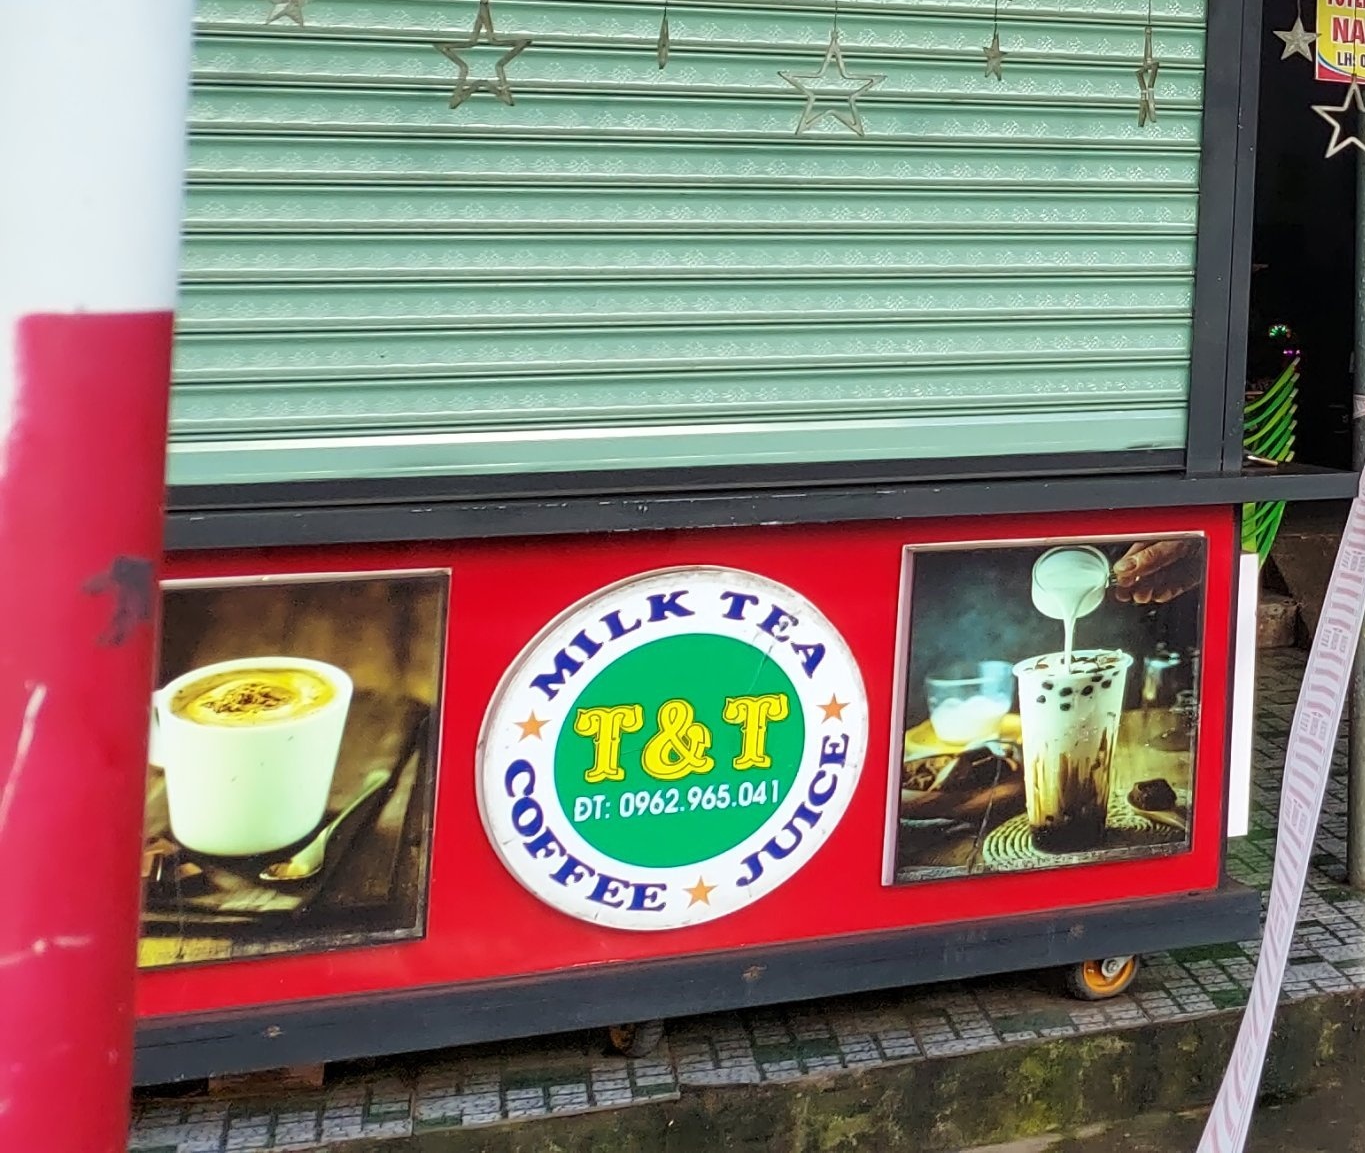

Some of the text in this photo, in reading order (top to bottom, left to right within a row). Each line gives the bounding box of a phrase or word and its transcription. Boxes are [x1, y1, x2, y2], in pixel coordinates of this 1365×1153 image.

[529, 589, 828, 702] MILK TEA
[504, 758, 668, 913] COFFEE
[573, 779, 780, 824] ĐT: 0962.965.041
[735, 732, 850, 889] JUICE
